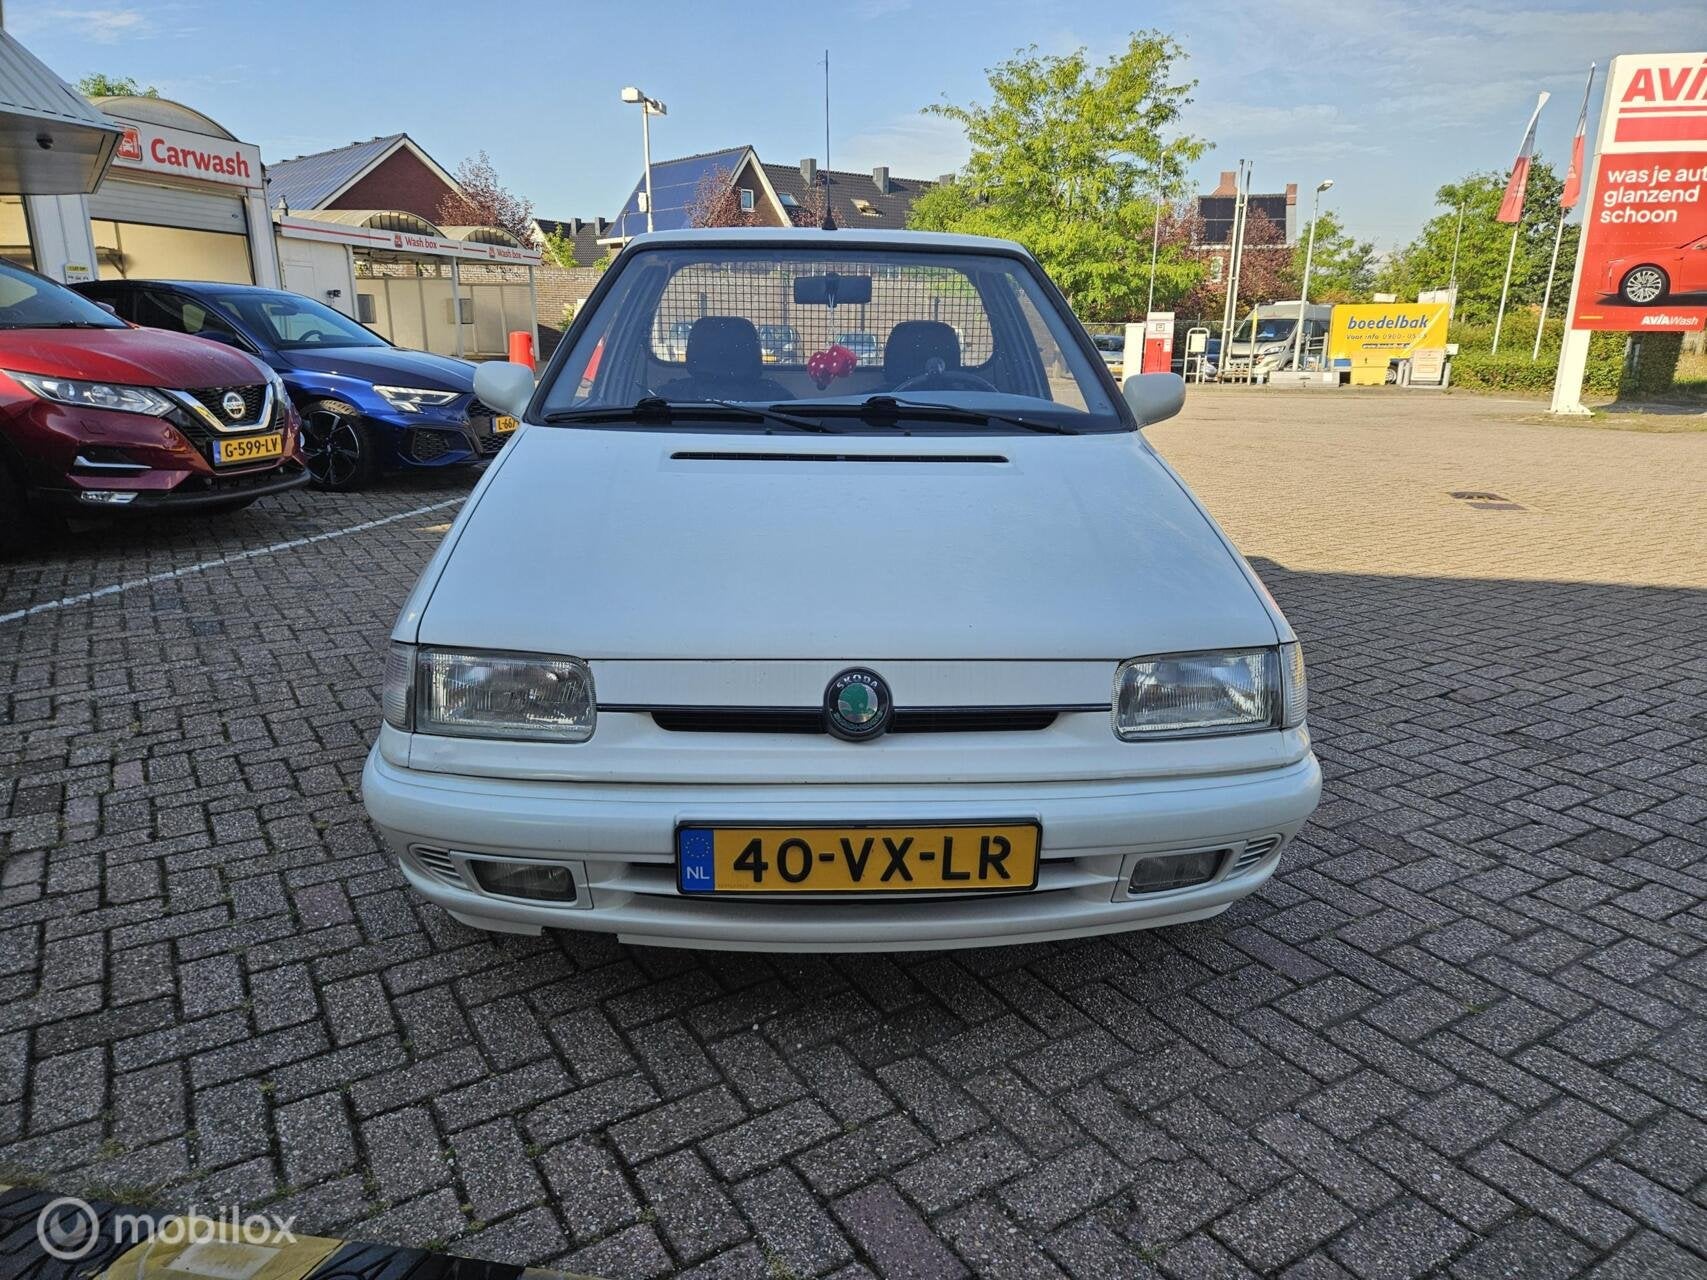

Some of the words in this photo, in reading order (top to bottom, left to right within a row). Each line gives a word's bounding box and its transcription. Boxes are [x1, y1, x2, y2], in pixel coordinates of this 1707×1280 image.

[1620, 58, 1707, 102] AVI
[150, 138, 250, 178] Carwash
[1608, 169, 1649, 183] was
[1648, 165, 1671, 187] je
[1603, 184, 1700, 207] glanzend
[1600, 206, 1678, 223] schoon
[404, 236, 425, 248] Wash
[425, 239, 437, 249] box
[1347, 314, 1429, 330] boedelbak
[224, 437, 278, 458] G-599-LV
[687, 867, 710, 880] NL
[733, 835, 1011, 883] 40-VX-LR
